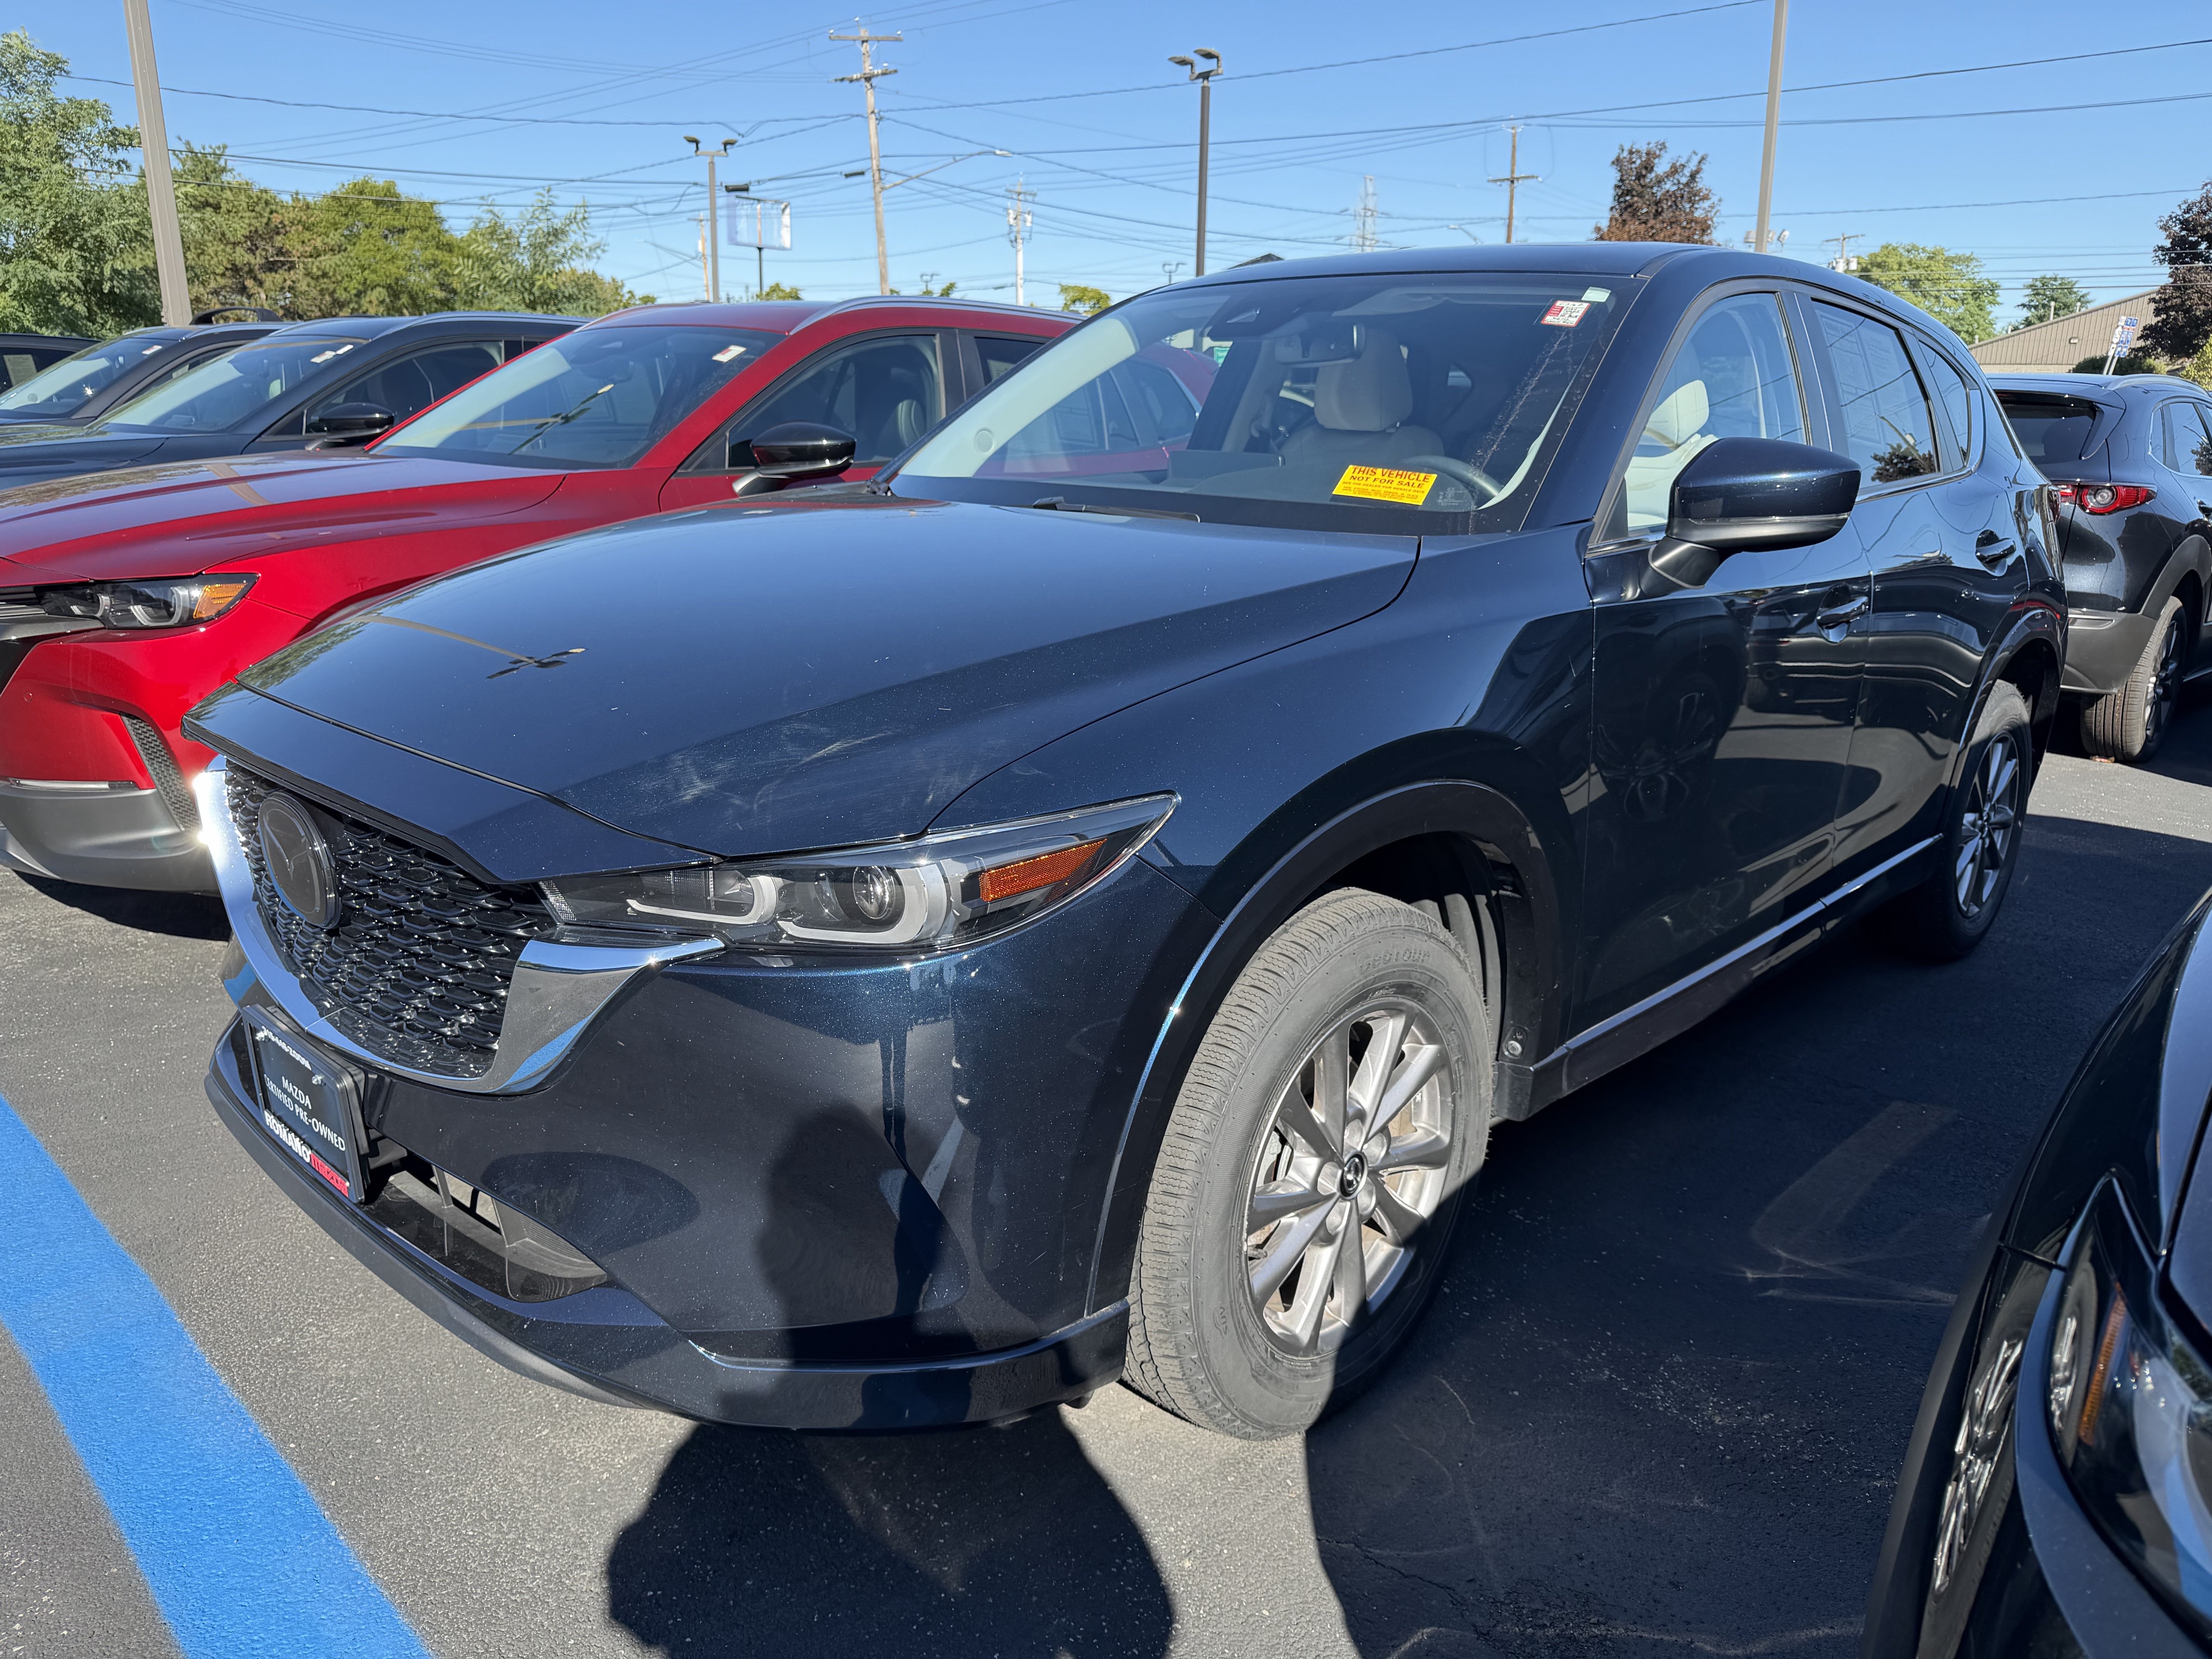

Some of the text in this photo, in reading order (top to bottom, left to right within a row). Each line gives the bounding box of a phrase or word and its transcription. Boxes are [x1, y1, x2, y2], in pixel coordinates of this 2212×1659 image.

[1351, 467, 1430, 483] THIS VEHICLE
[264, 1074, 345, 1151] CERTIFIED PRE-OWNED
[282, 1076, 311, 1109] MAZDA
[264, 1110, 311, 1163] ROMANO
